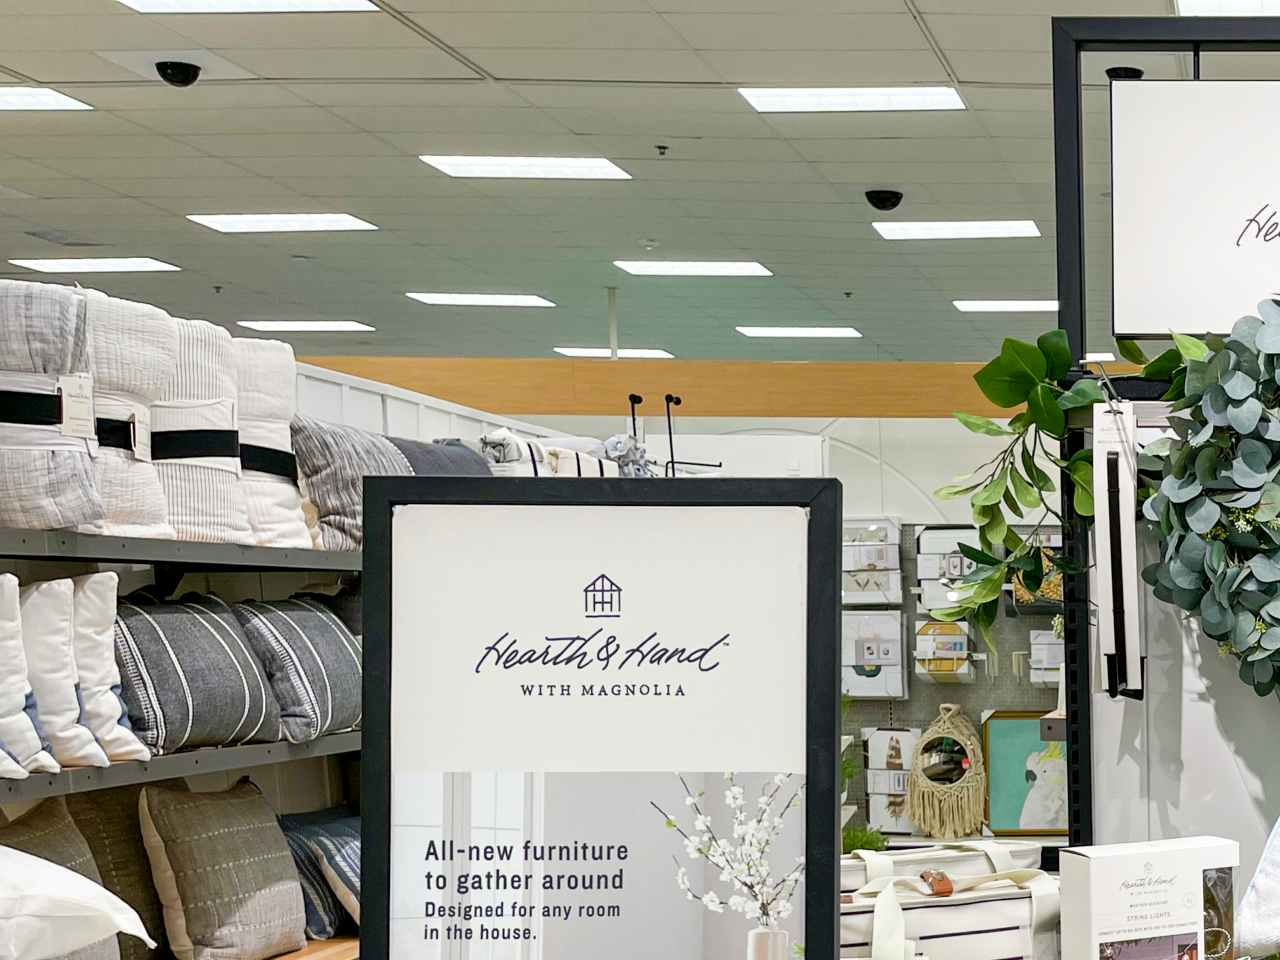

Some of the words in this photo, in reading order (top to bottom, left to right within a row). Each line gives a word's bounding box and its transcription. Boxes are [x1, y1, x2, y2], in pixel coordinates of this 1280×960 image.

[475, 628, 603, 674] Hearth
[596, 635, 620, 671] &
[618, 631, 730, 673] Hand
[520, 684, 572, 697] WITH
[580, 683, 686, 697] MAGNOLIA
[425, 839, 514, 861] All-new
[522, 839, 629, 861] furniture
[425, 871, 447, 890] to
[457, 869, 533, 895] gather
[542, 868, 624, 890] around
[424, 902, 504, 921] Designed
[511, 901, 536, 918] for
[542, 905, 572, 921] any
[578, 905, 620, 918] room
[424, 924, 439, 940] in
[447, 924, 473, 940] the
[480, 924, 537, 940] house.
